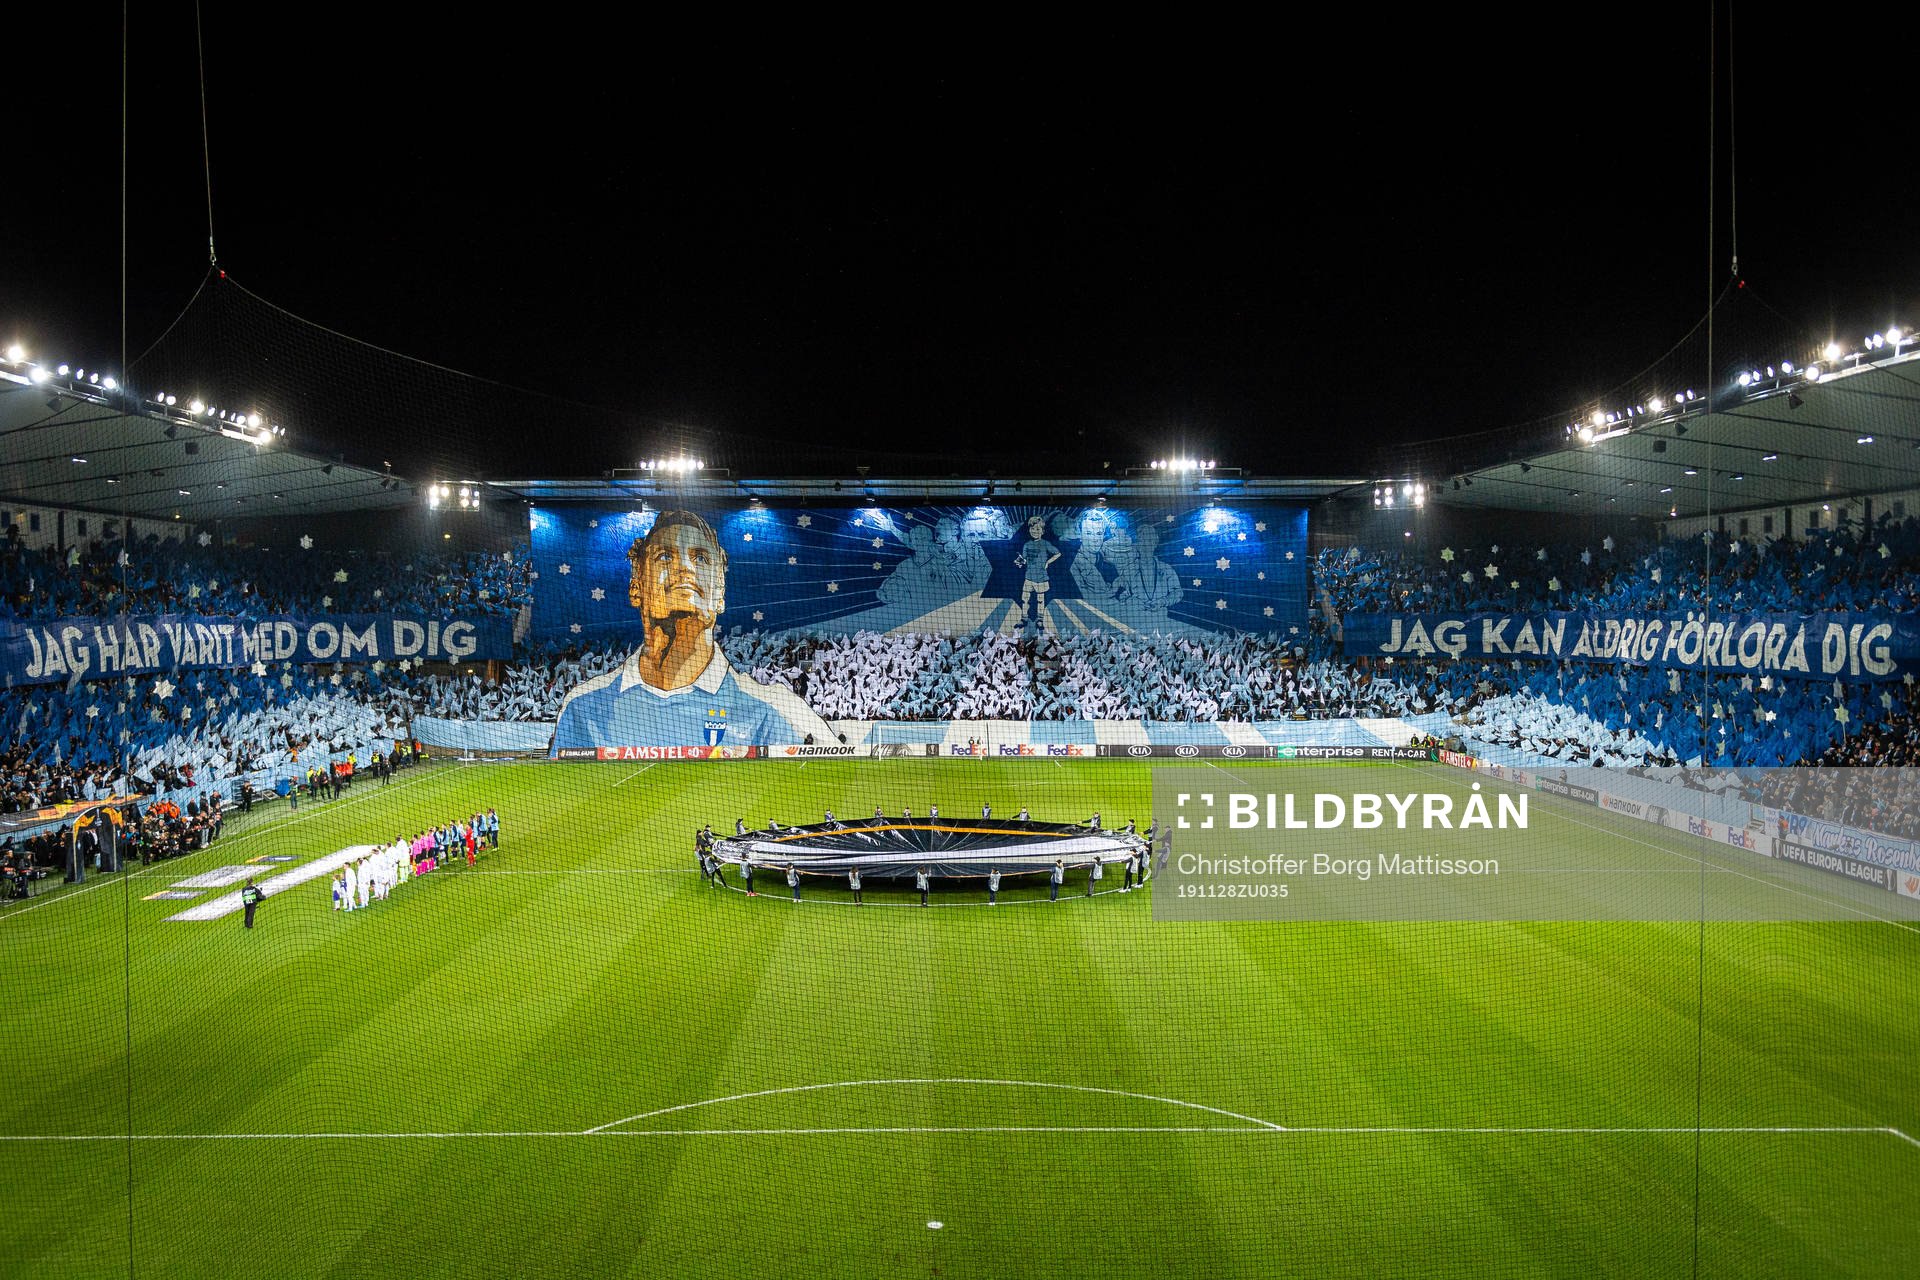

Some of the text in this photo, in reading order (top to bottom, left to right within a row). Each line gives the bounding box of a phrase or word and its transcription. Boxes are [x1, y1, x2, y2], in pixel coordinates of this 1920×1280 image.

[24, 620, 477, 679] JAG HAR VARIT MED OM DIG
[1379, 611, 1898, 676] JAG KAN ALDRIG FÖRLORA DIG
[623, 746, 686, 759] AMSTEL
[1000, 744, 1034, 756] FedEx
[1047, 744, 1083, 756] FedEx
[1283, 746, 1427, 759] enterprise RENT-A-CAR
[1445, 751, 1467, 768] AMSTEL
[1536, 778, 1569, 795] enterprise
[1688, 816, 1713, 839] FedEx
[1728, 826, 1756, 850] FedEx
[1782, 843, 1884, 884] UEFA EUROPA LEAGUE
